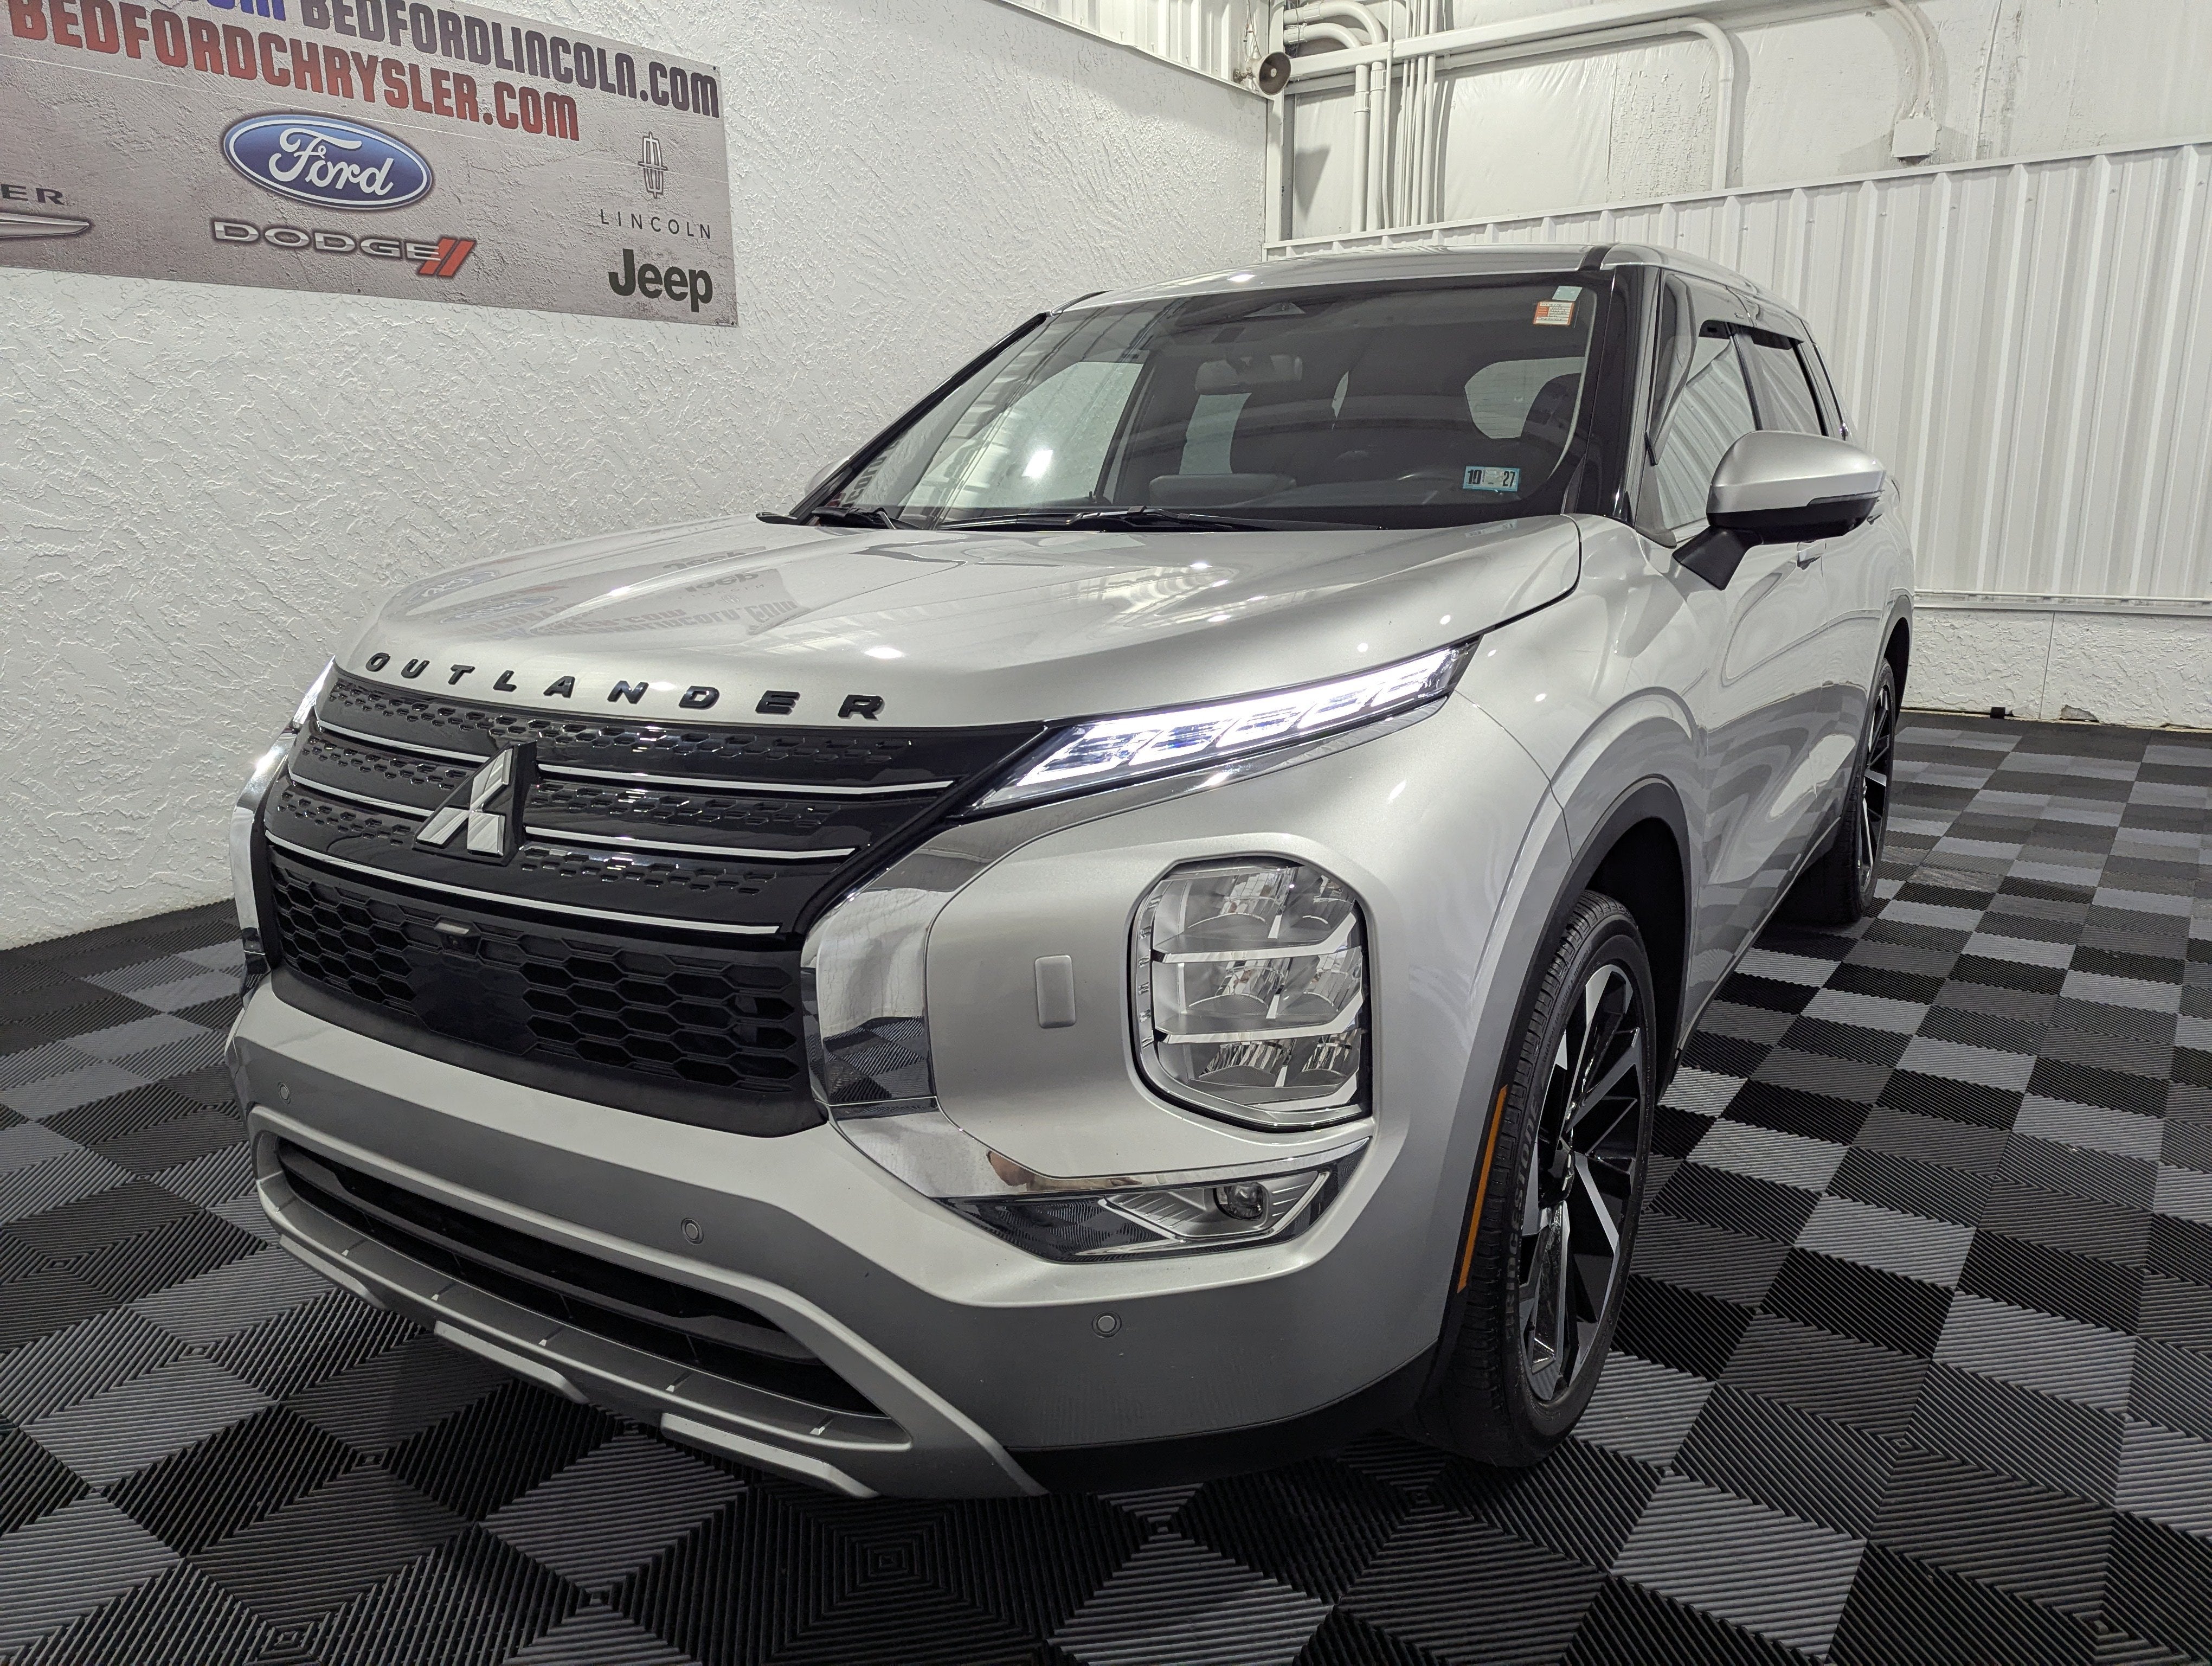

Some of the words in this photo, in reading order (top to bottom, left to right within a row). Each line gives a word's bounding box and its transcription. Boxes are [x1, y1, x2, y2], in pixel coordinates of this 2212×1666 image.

[9, 0, 580, 142] BEDFORDCHRYSLER.COM
[300, 0, 720, 118] BEDFORDLINCOLN.COM
[269, 128, 394, 196] Ford
[214, 221, 441, 262] DODGE
[600, 208, 711, 240] LINCOLN
[608, 248, 713, 313] Jeep
[1467, 469, 1482, 485] 10
[1502, 471, 1516, 487] 27
[365, 652, 885, 720] OUTLANDER
